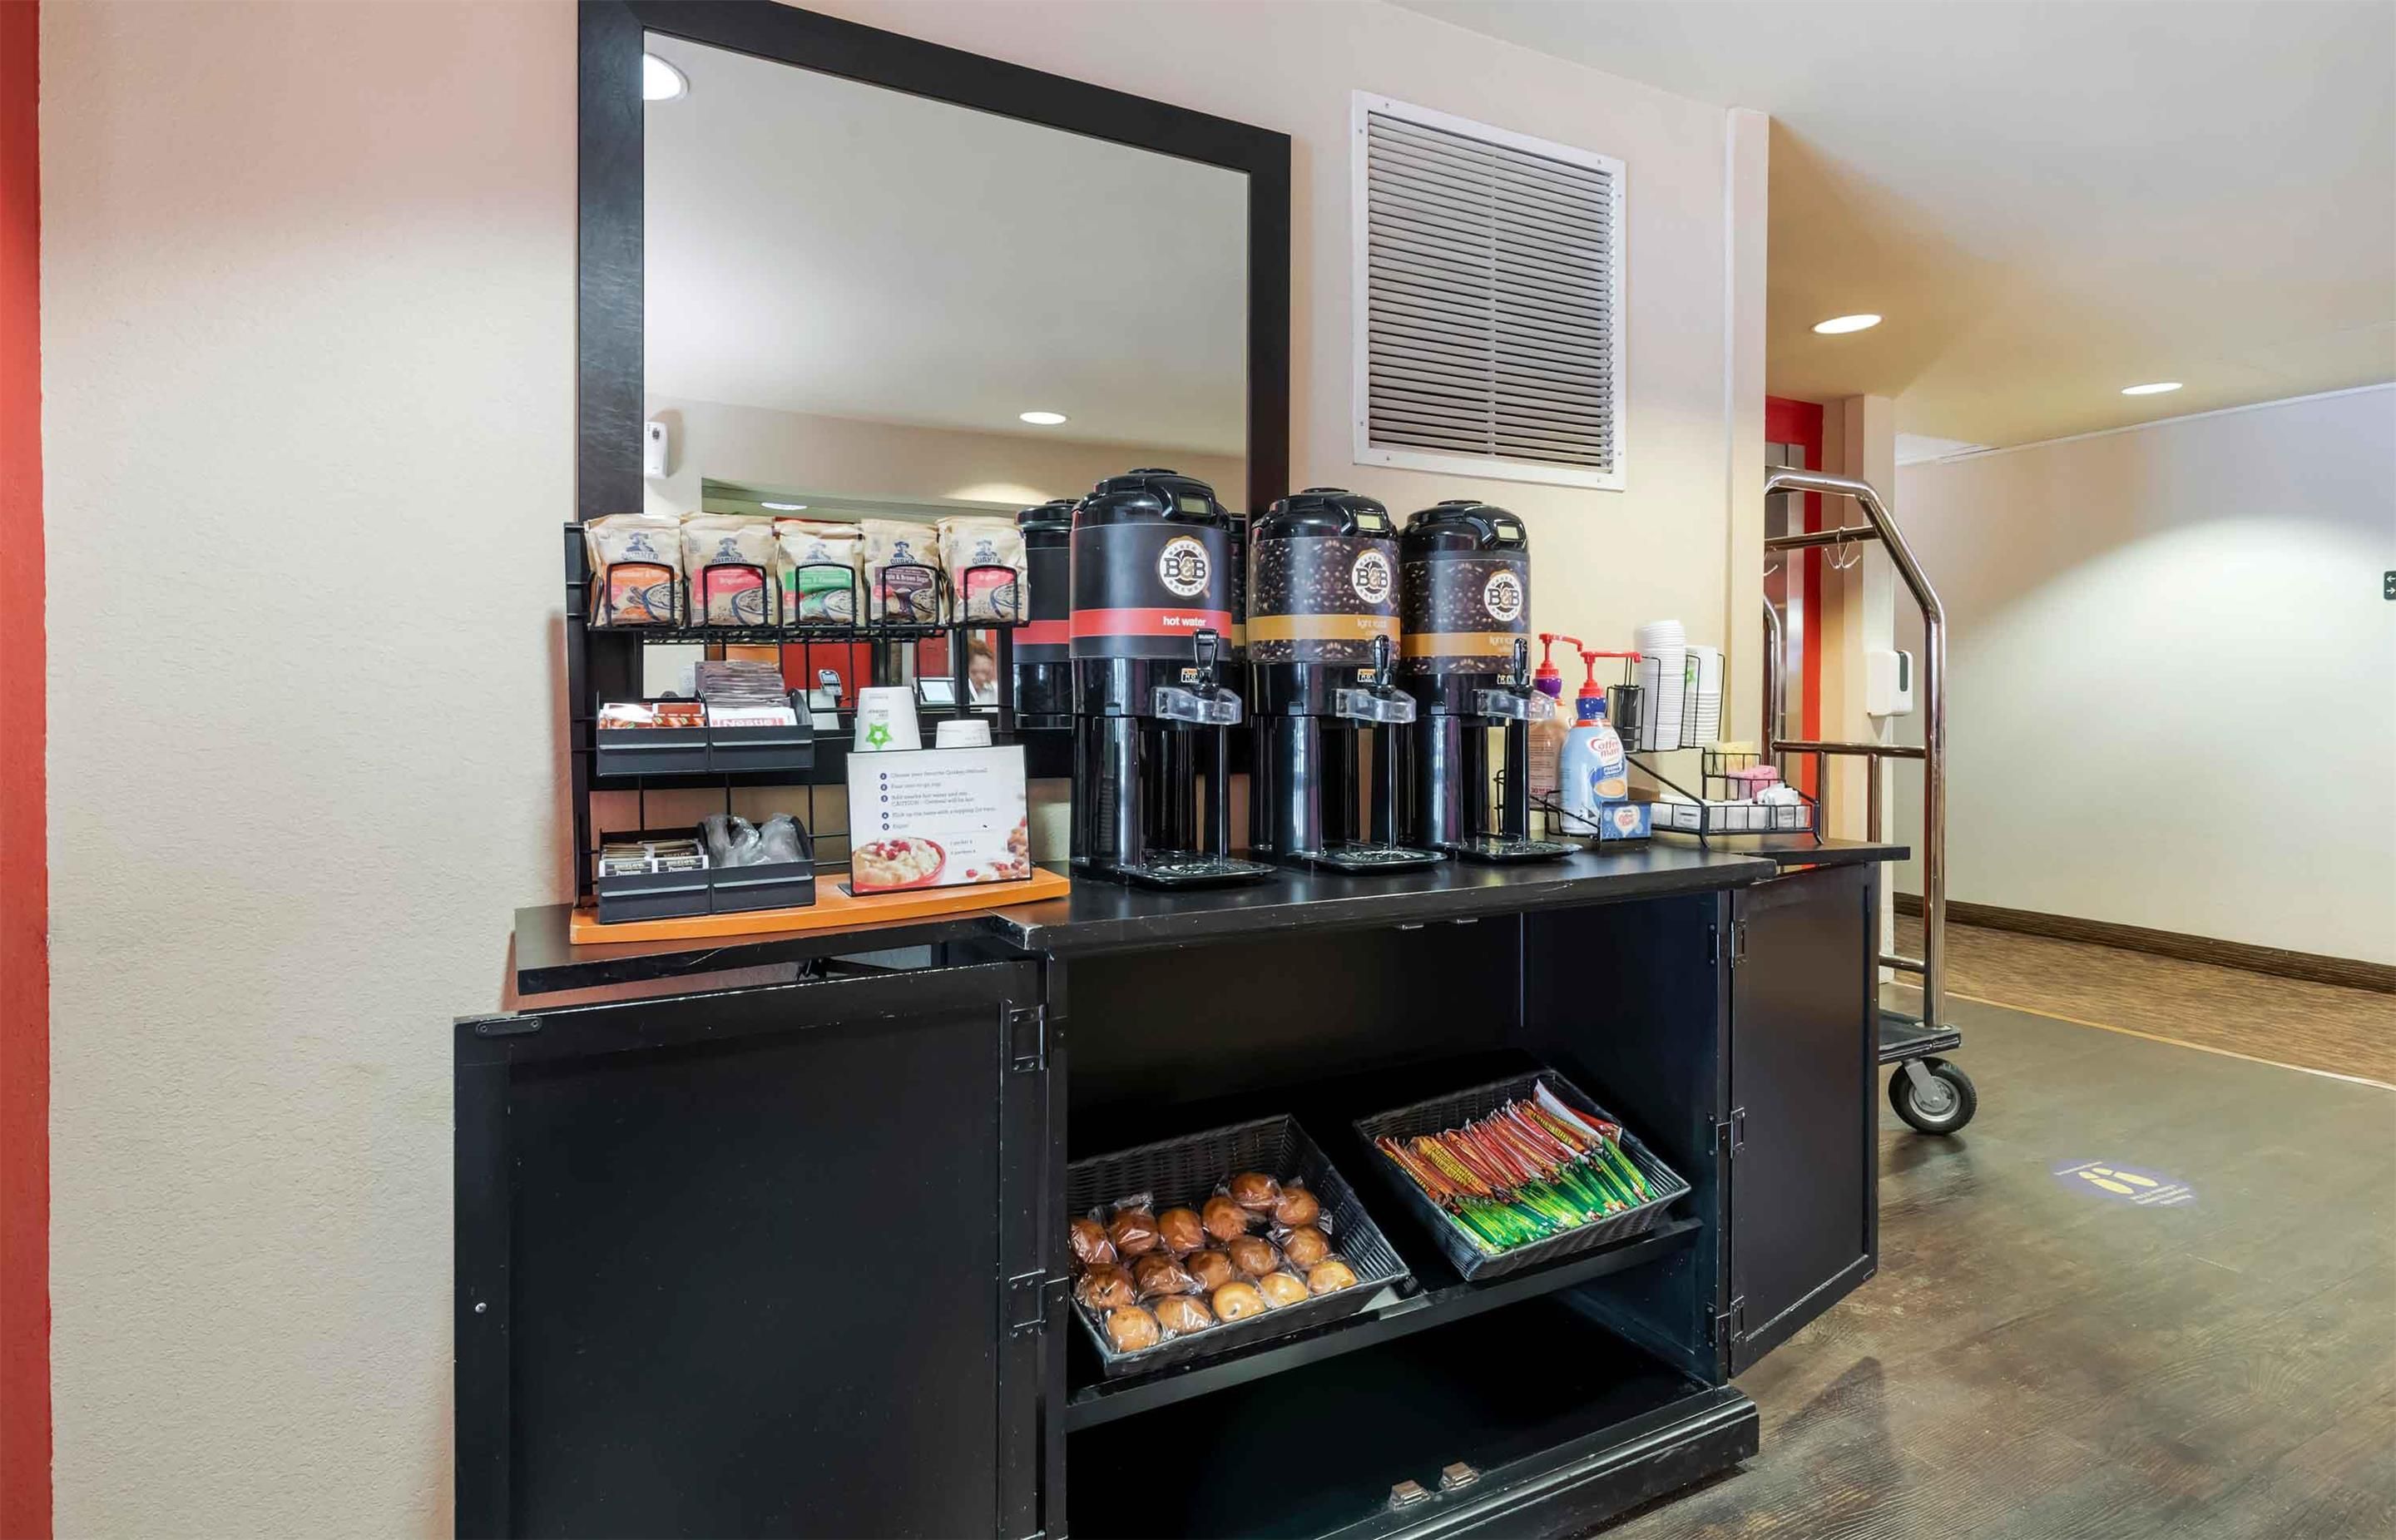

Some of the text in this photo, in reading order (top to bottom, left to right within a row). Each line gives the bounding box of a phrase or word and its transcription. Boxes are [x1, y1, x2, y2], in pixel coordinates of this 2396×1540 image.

[972, 556, 1002, 565] QUAKER
[1164, 557, 1206, 579] B&B
[1356, 567, 1389, 587] B&B
[1163, 616, 1206, 626] hot water
